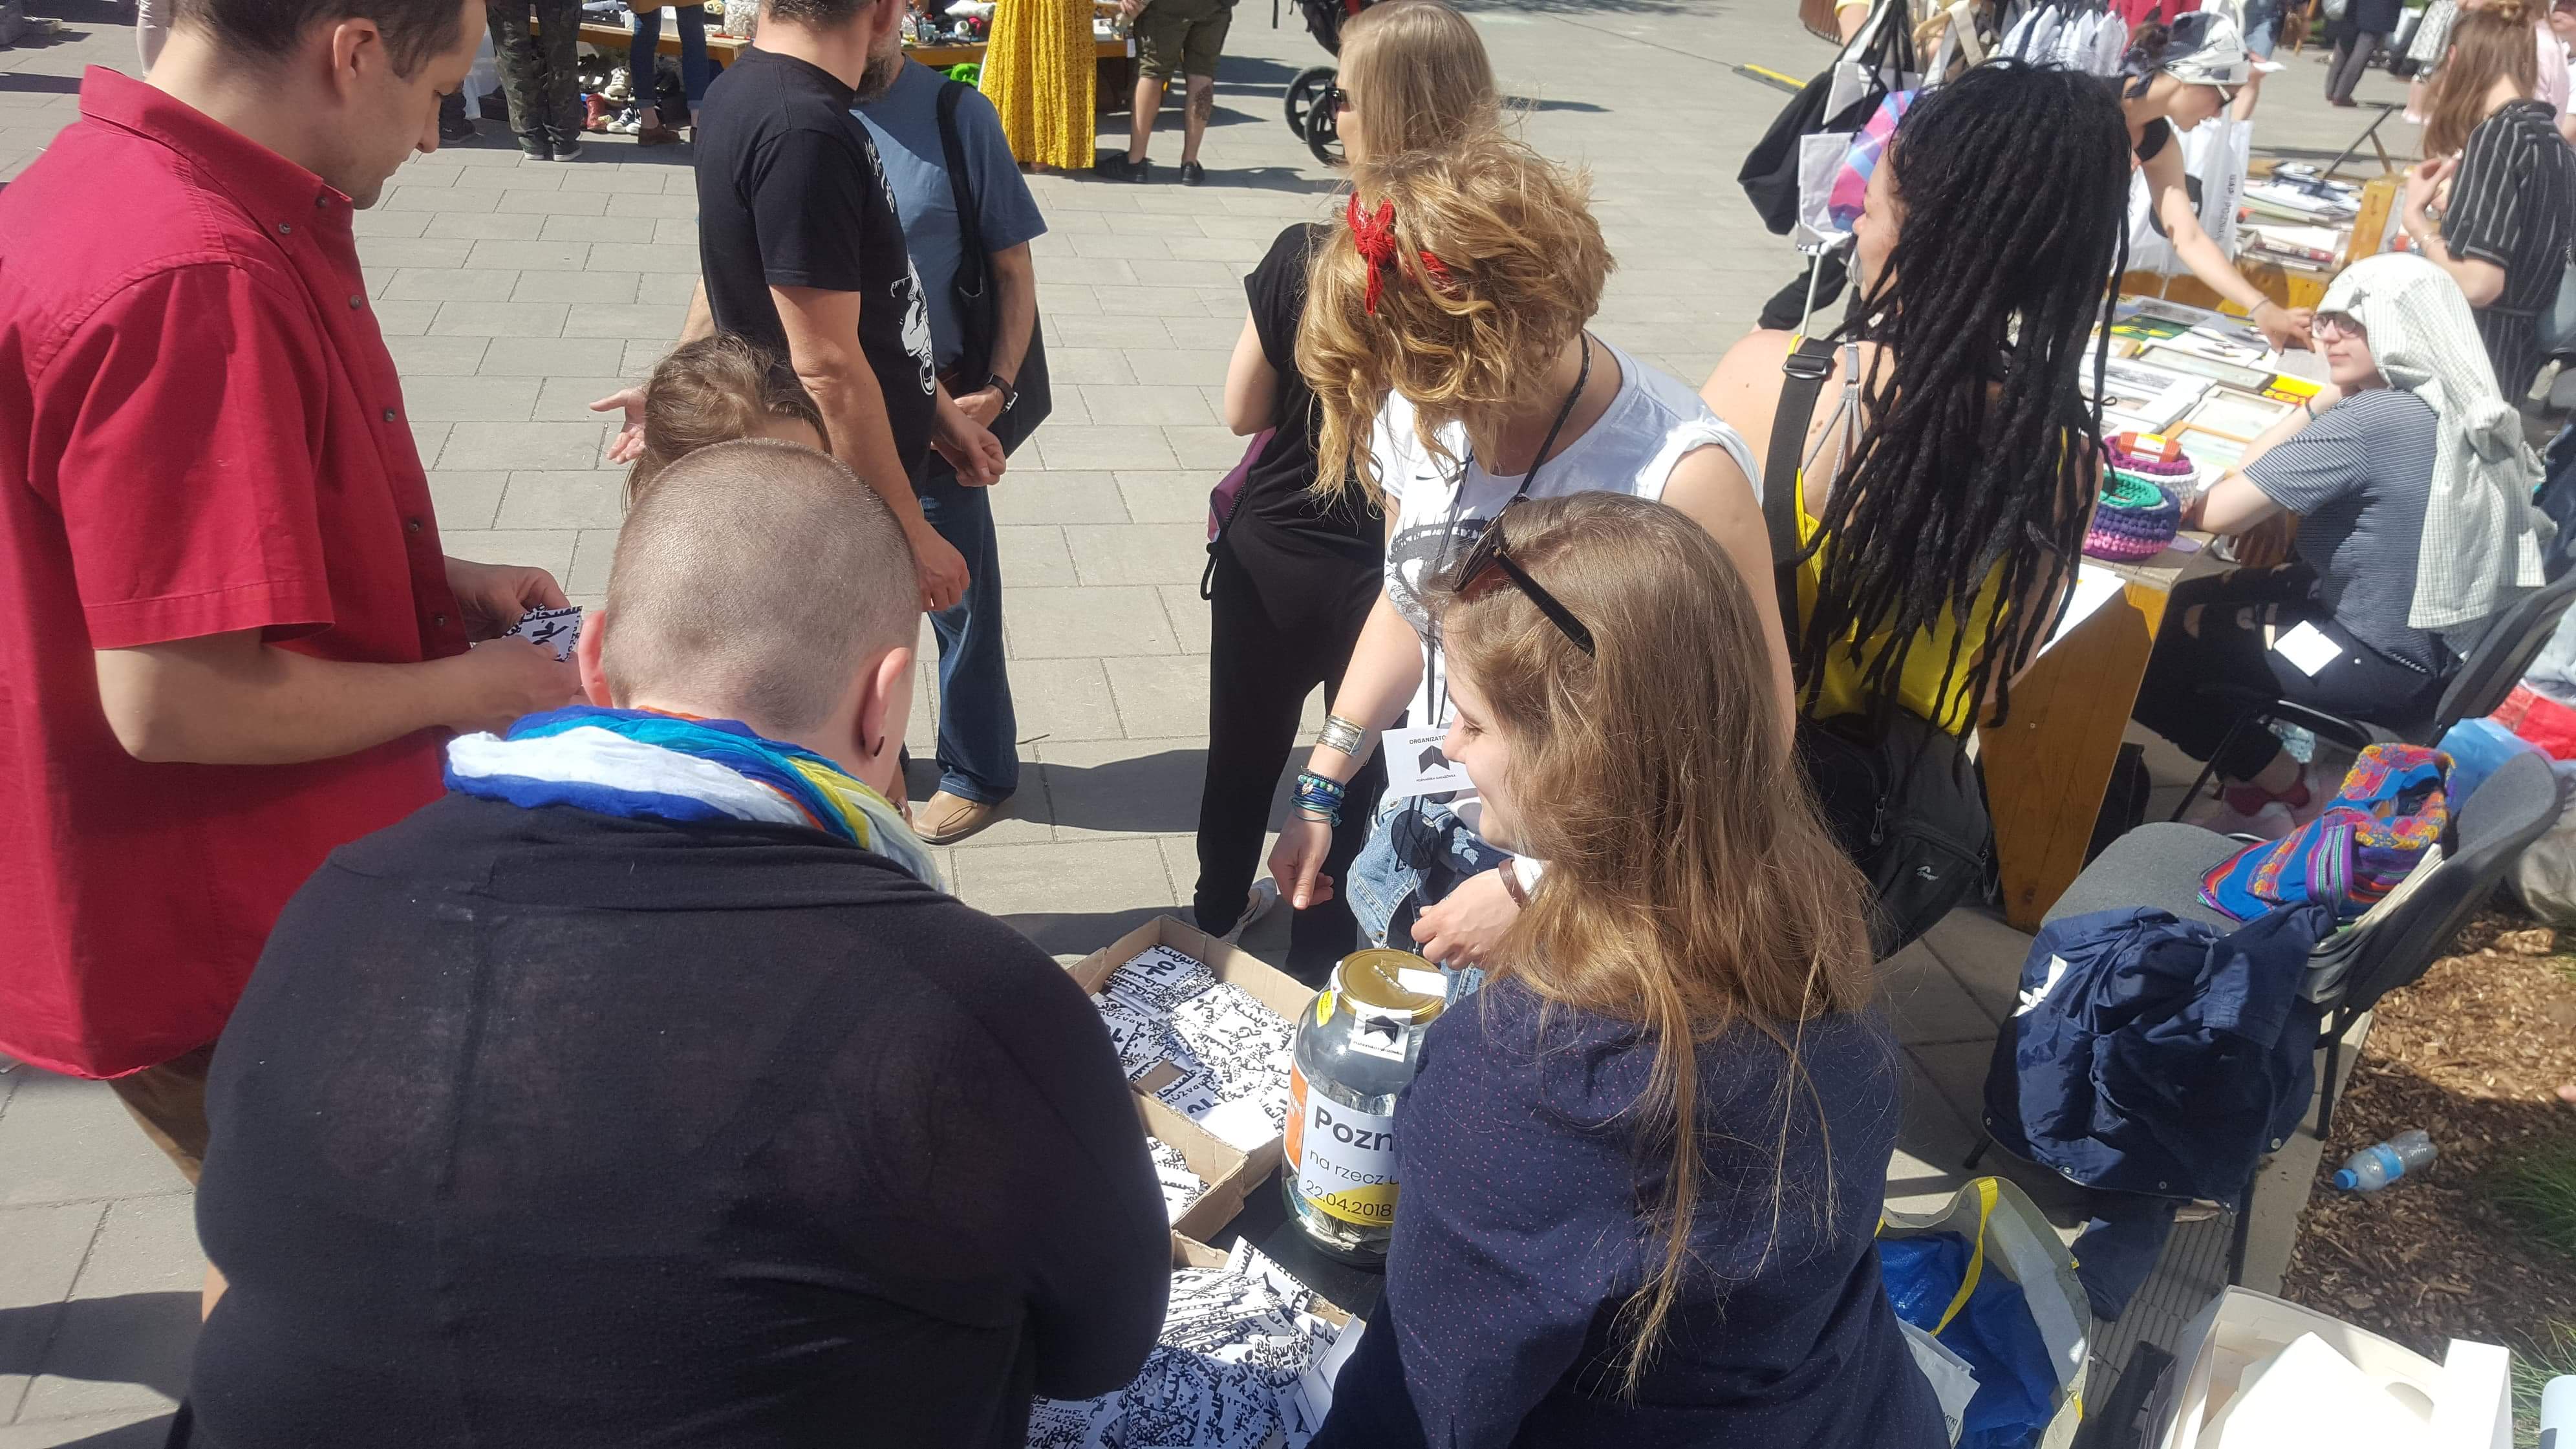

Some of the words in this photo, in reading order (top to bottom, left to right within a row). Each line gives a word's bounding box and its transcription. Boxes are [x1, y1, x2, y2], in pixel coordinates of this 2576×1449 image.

[1315, 1105, 1393, 1152] Pozn
[1309, 1150, 1330, 1170] na
[1335, 1165, 1384, 1185] rzecz
[1305, 1179, 1392, 1217] 22.04.2018
